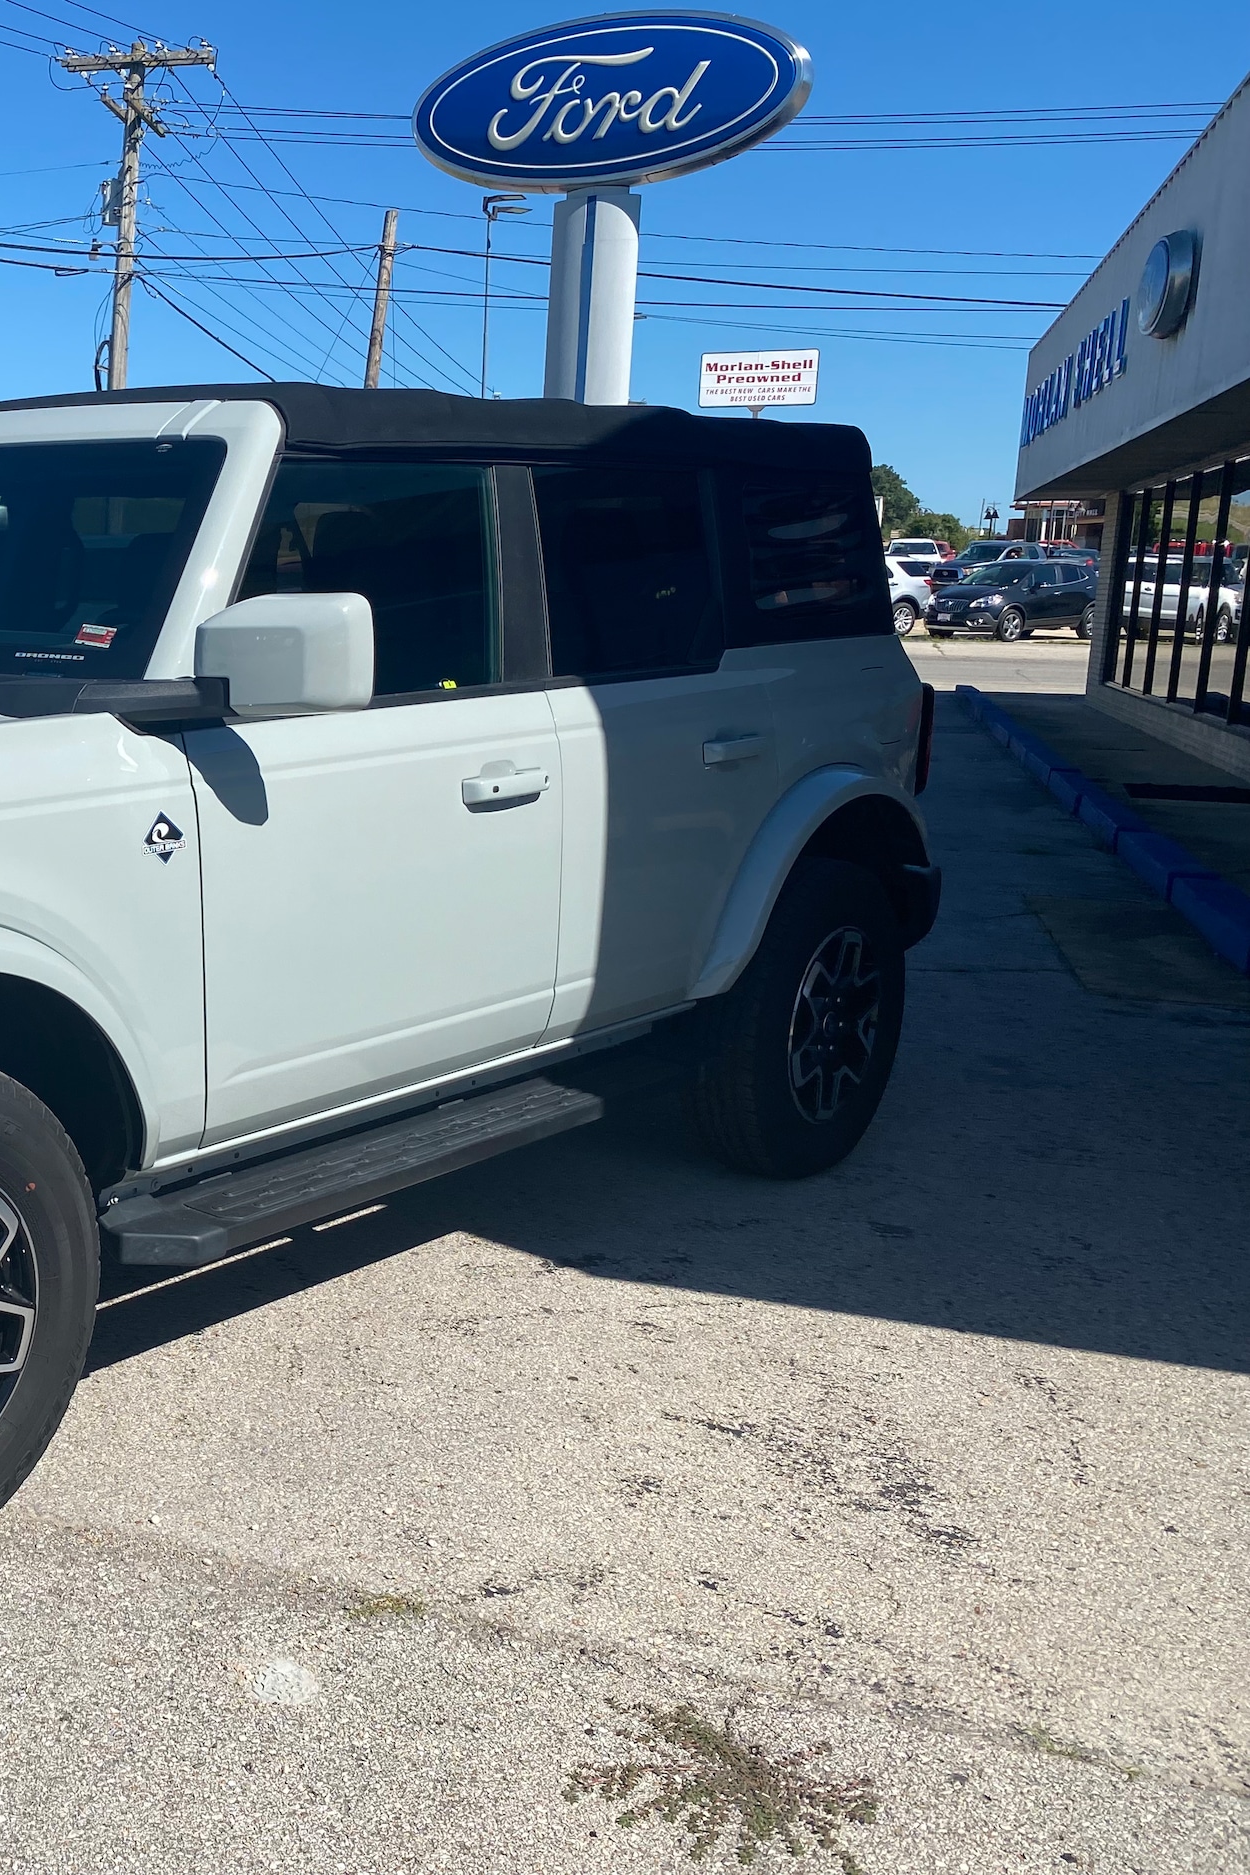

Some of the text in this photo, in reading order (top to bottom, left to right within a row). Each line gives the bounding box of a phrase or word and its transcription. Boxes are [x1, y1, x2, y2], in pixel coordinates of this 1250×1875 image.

[487, 47, 712, 152] Ford
[1072, 296, 1130, 409] SHELL
[706, 360, 814, 372] Morlan-Shell
[716, 372, 802, 384] Preowned
[14, 652, 85, 660] BRONCO
[144, 844, 164, 854] OUTER
